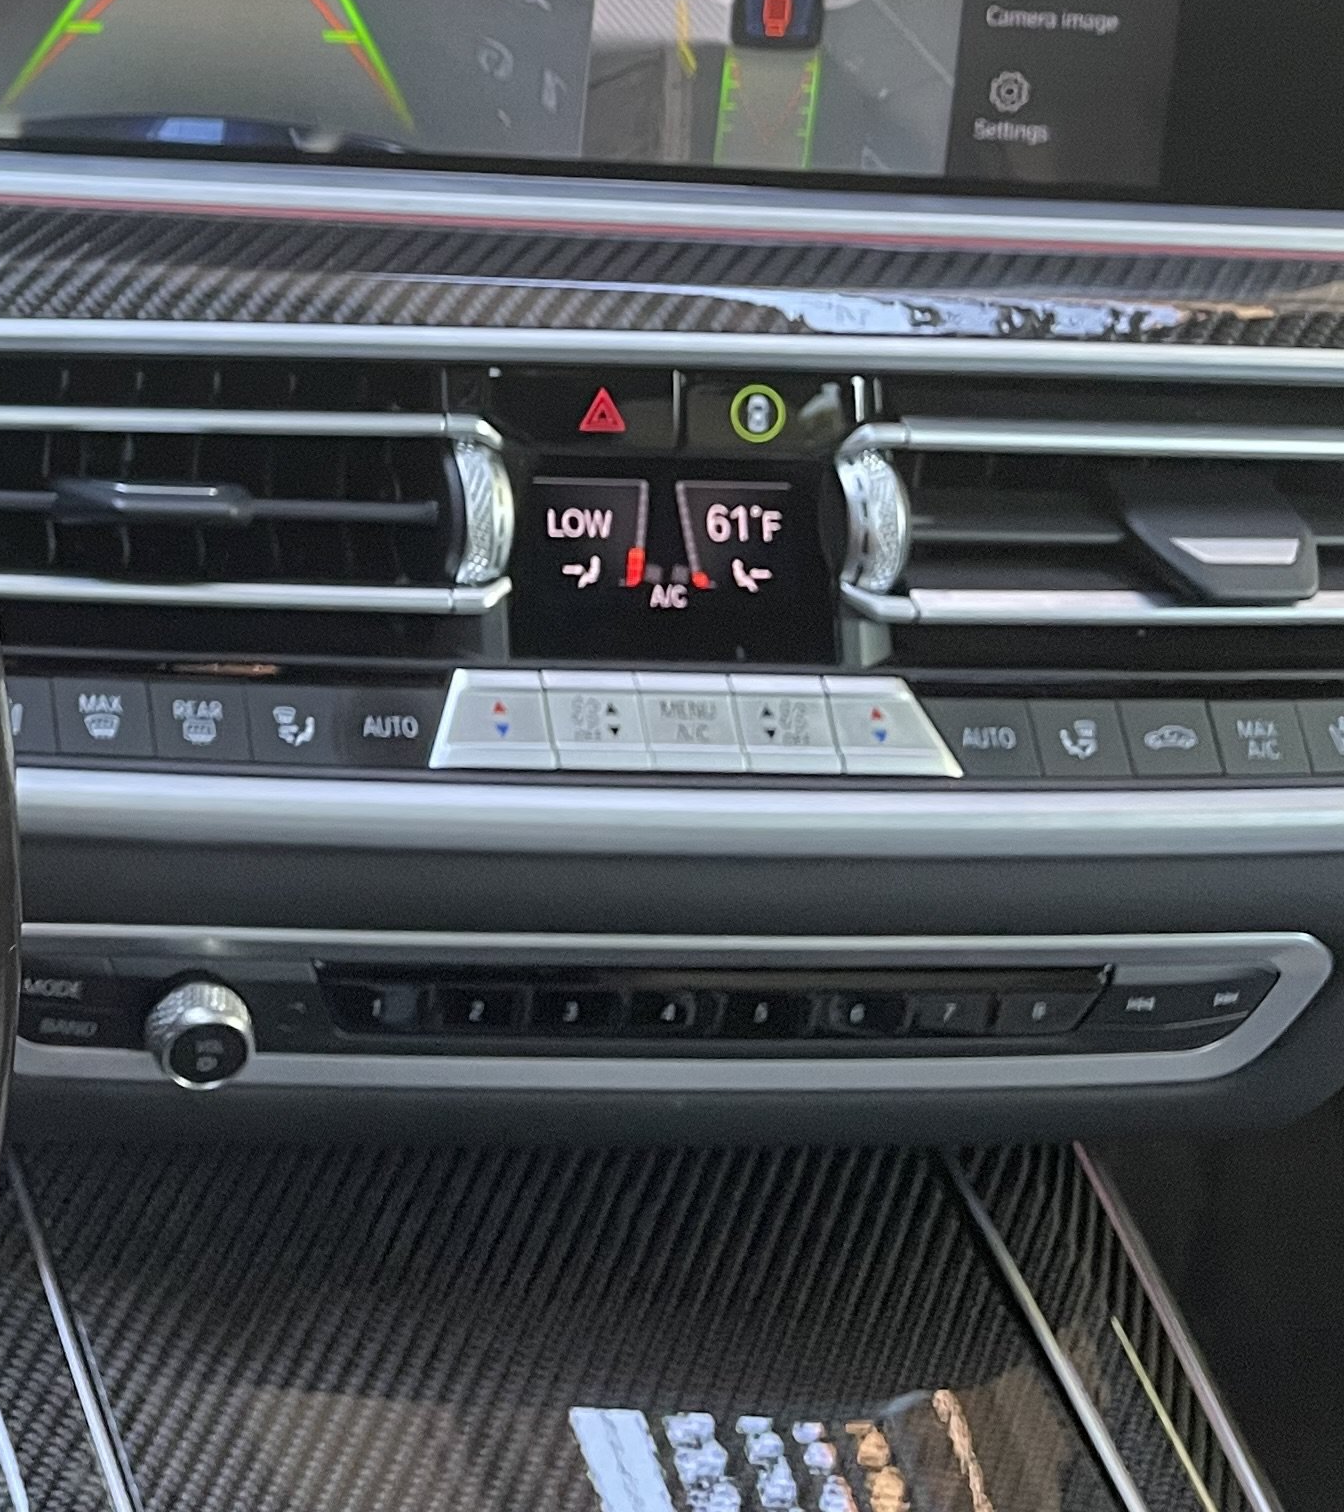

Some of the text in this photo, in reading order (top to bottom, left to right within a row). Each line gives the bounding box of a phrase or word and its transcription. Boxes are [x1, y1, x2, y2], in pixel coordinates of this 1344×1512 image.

[986, 4, 1057, 29] Camera
[974, 118, 1052, 145] Settings
[546, 507, 614, 540] LOW
[706, 503, 784, 543] 61°F
[649, 583, 689, 610] A/C
[78, 693, 123, 714] MAX
[172, 699, 223, 722] REAR
[362, 715, 419, 740] AUTO
[962, 725, 1016, 749] AUTO
[1237, 719, 1279, 738] MAX
